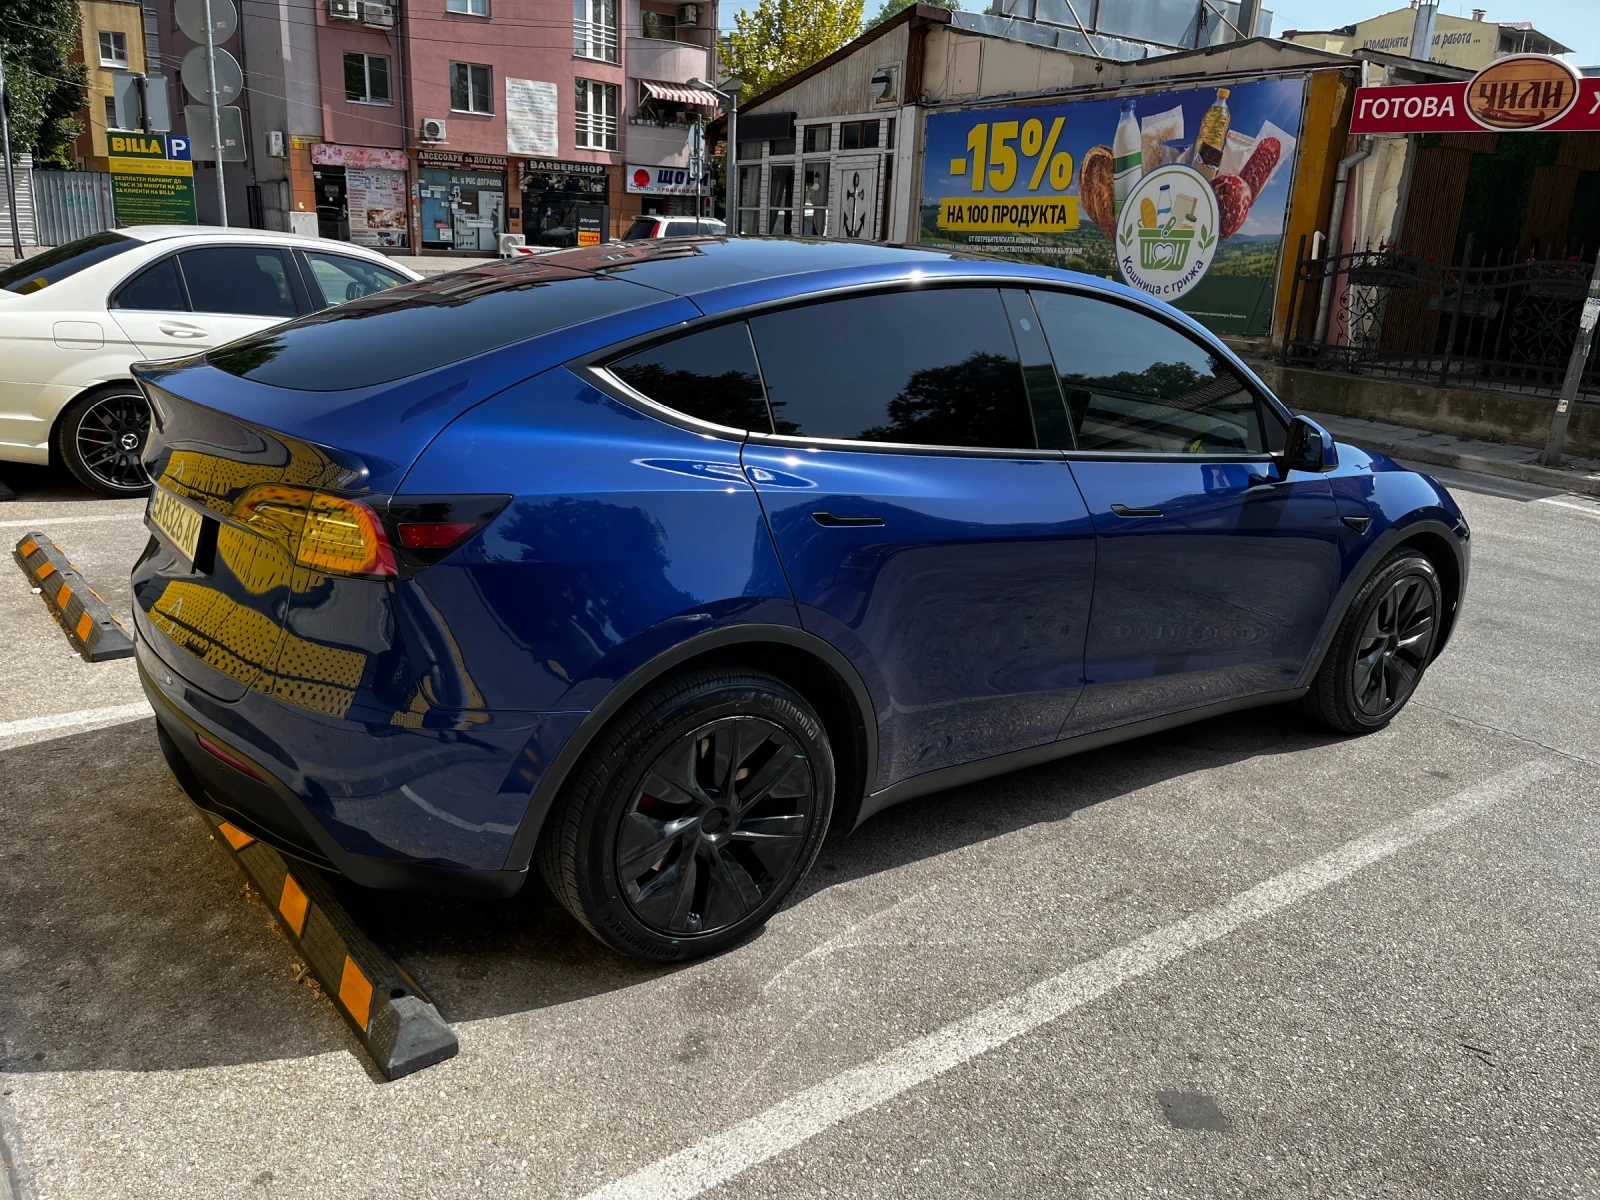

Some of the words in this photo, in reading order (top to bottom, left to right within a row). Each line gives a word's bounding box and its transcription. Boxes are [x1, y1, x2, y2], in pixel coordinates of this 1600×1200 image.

[1363, 36, 1409, 51] изолацията
[1441, 32, 1473, 48] работа
[1479, 80, 1564, 109] ЧИЛИ
[1359, 96, 1455, 119] ГОТОВА
[112, 137, 162, 154] BILLA
[171, 139, 187, 156] P
[950, 116, 1074, 192] -15%
[418, 151, 463, 162] АКСЕСОАРИ
[473, 156, 508, 166] ДОГРАМА
[530, 161, 603, 174] BARBERSHOP
[947, 205, 964, 223] НА
[967, 205, 988, 223] 100
[991, 204, 1067, 228] ПРОДУКТА
[974, 235, 1015, 243] ПОТРЕБИТЕЛСКАТА
[1016, 236, 1039, 245] КОШНИЦА
[986, 245, 1023, 253] ПРАВИТЕЛСТВОТО
[1031, 246, 1057, 254] РЕПУБЛИКА
[1122, 255, 1161, 295] Кошница
[1163, 286, 1170, 294] с
[1172, 260, 1204, 292] грижа
[761, 694, 819, 741] Continental
